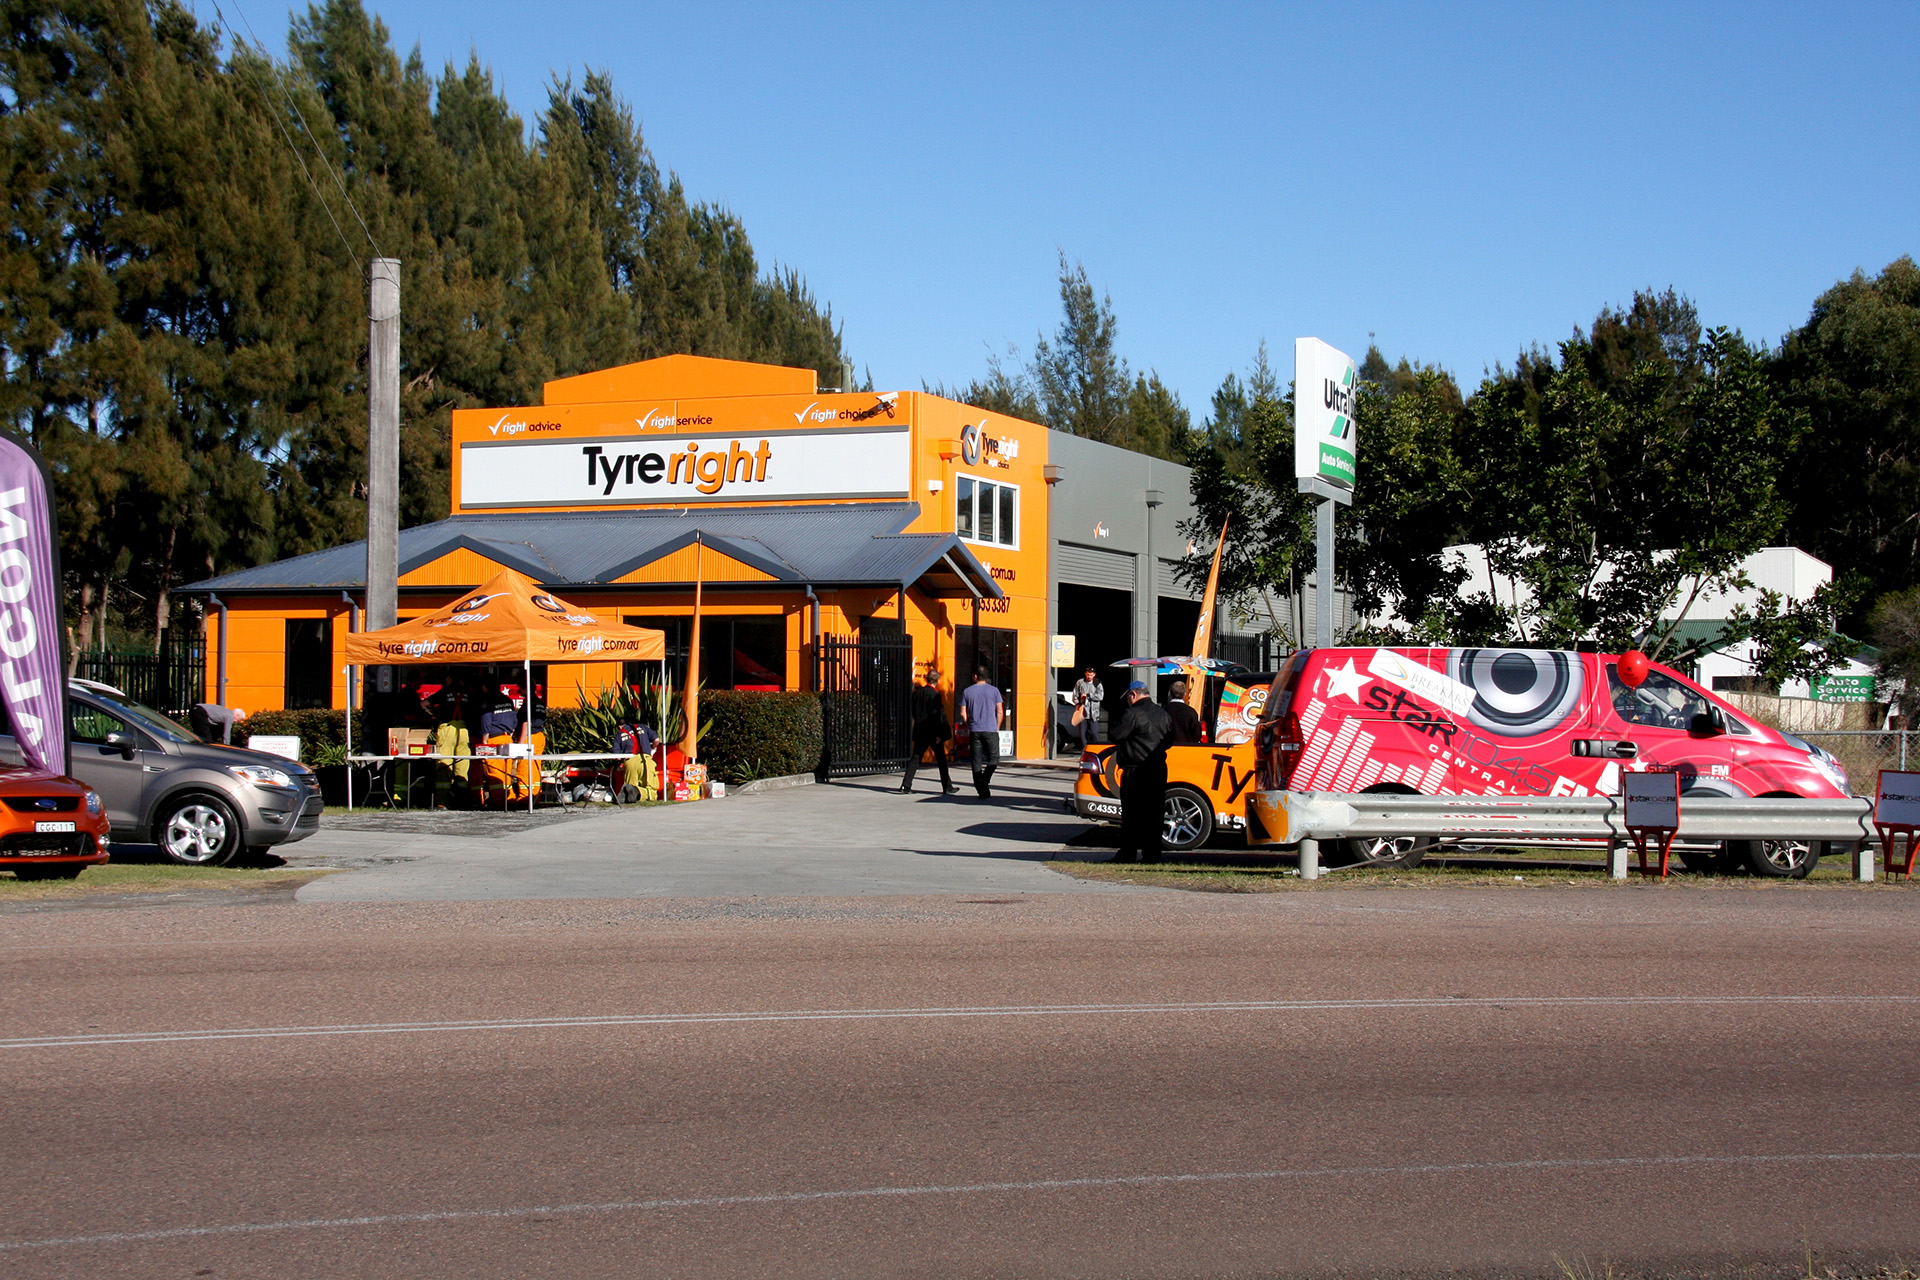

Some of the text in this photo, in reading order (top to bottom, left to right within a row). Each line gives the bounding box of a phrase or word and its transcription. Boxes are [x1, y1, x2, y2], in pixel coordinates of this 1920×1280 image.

[650, 414, 713, 429] right service
[811, 408, 875, 422] right choice
[502, 421, 562, 435] right advice
[981, 431, 1019, 461] Tyreright
[1321, 451, 1336, 467] Auto
[582, 438, 772, 495] Tyreright
[378, 638, 489, 659] tyreright.com.au
[557, 635, 640, 655] tyreright.com.au
[1825, 677, 1859, 686] Auto
[1816, 685, 1869, 694] Service
[1819, 694, 1866, 702] Centre
[1427, 743, 1518, 795] CENTRAL
[1711, 764, 1729, 776] FM
[1096, 803, 1118, 815] 4353
